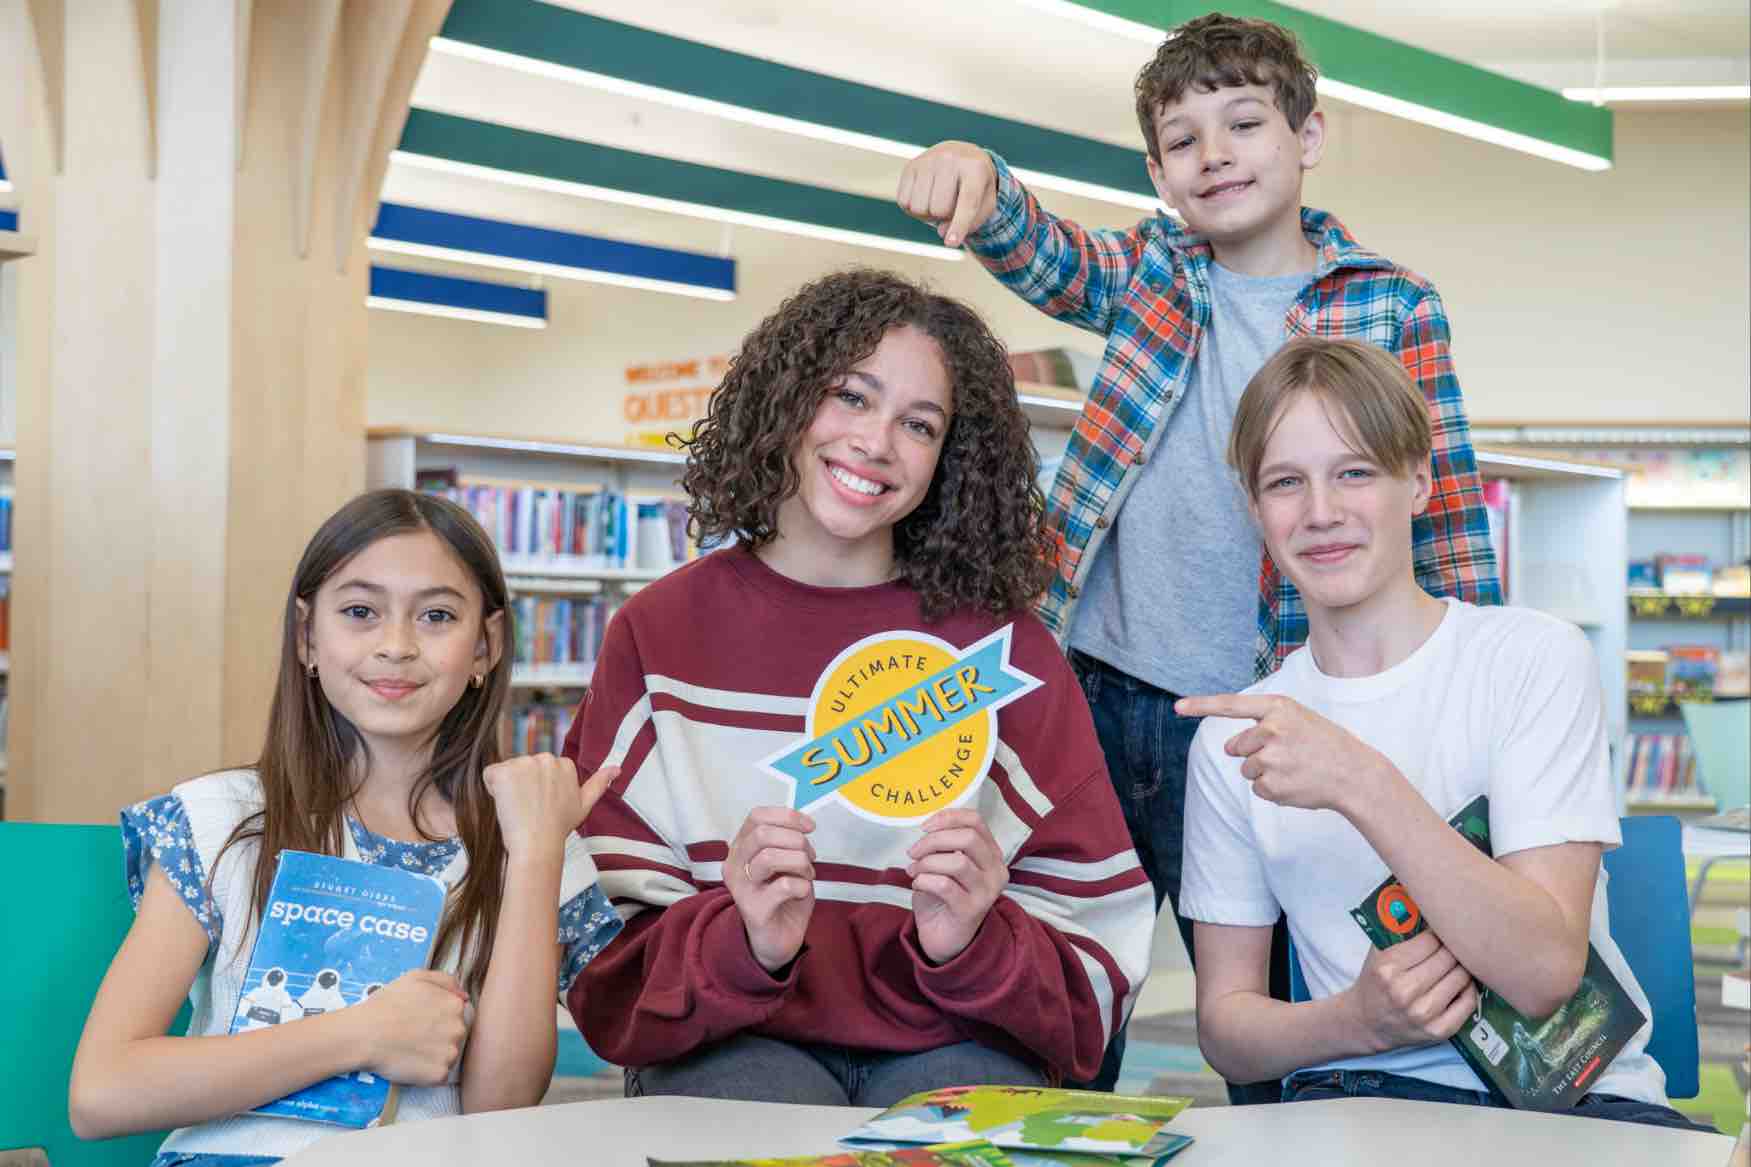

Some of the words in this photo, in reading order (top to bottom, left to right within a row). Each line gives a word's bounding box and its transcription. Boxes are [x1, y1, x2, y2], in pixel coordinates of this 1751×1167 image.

[830, 654, 928, 713] ULTIMATE
[800, 665, 997, 787] SUMMER
[870, 733, 974, 805] CHALLENGE
[270, 899, 356, 928] space
[359, 913, 428, 943] case
[1479, 1026, 1489, 1041] J
